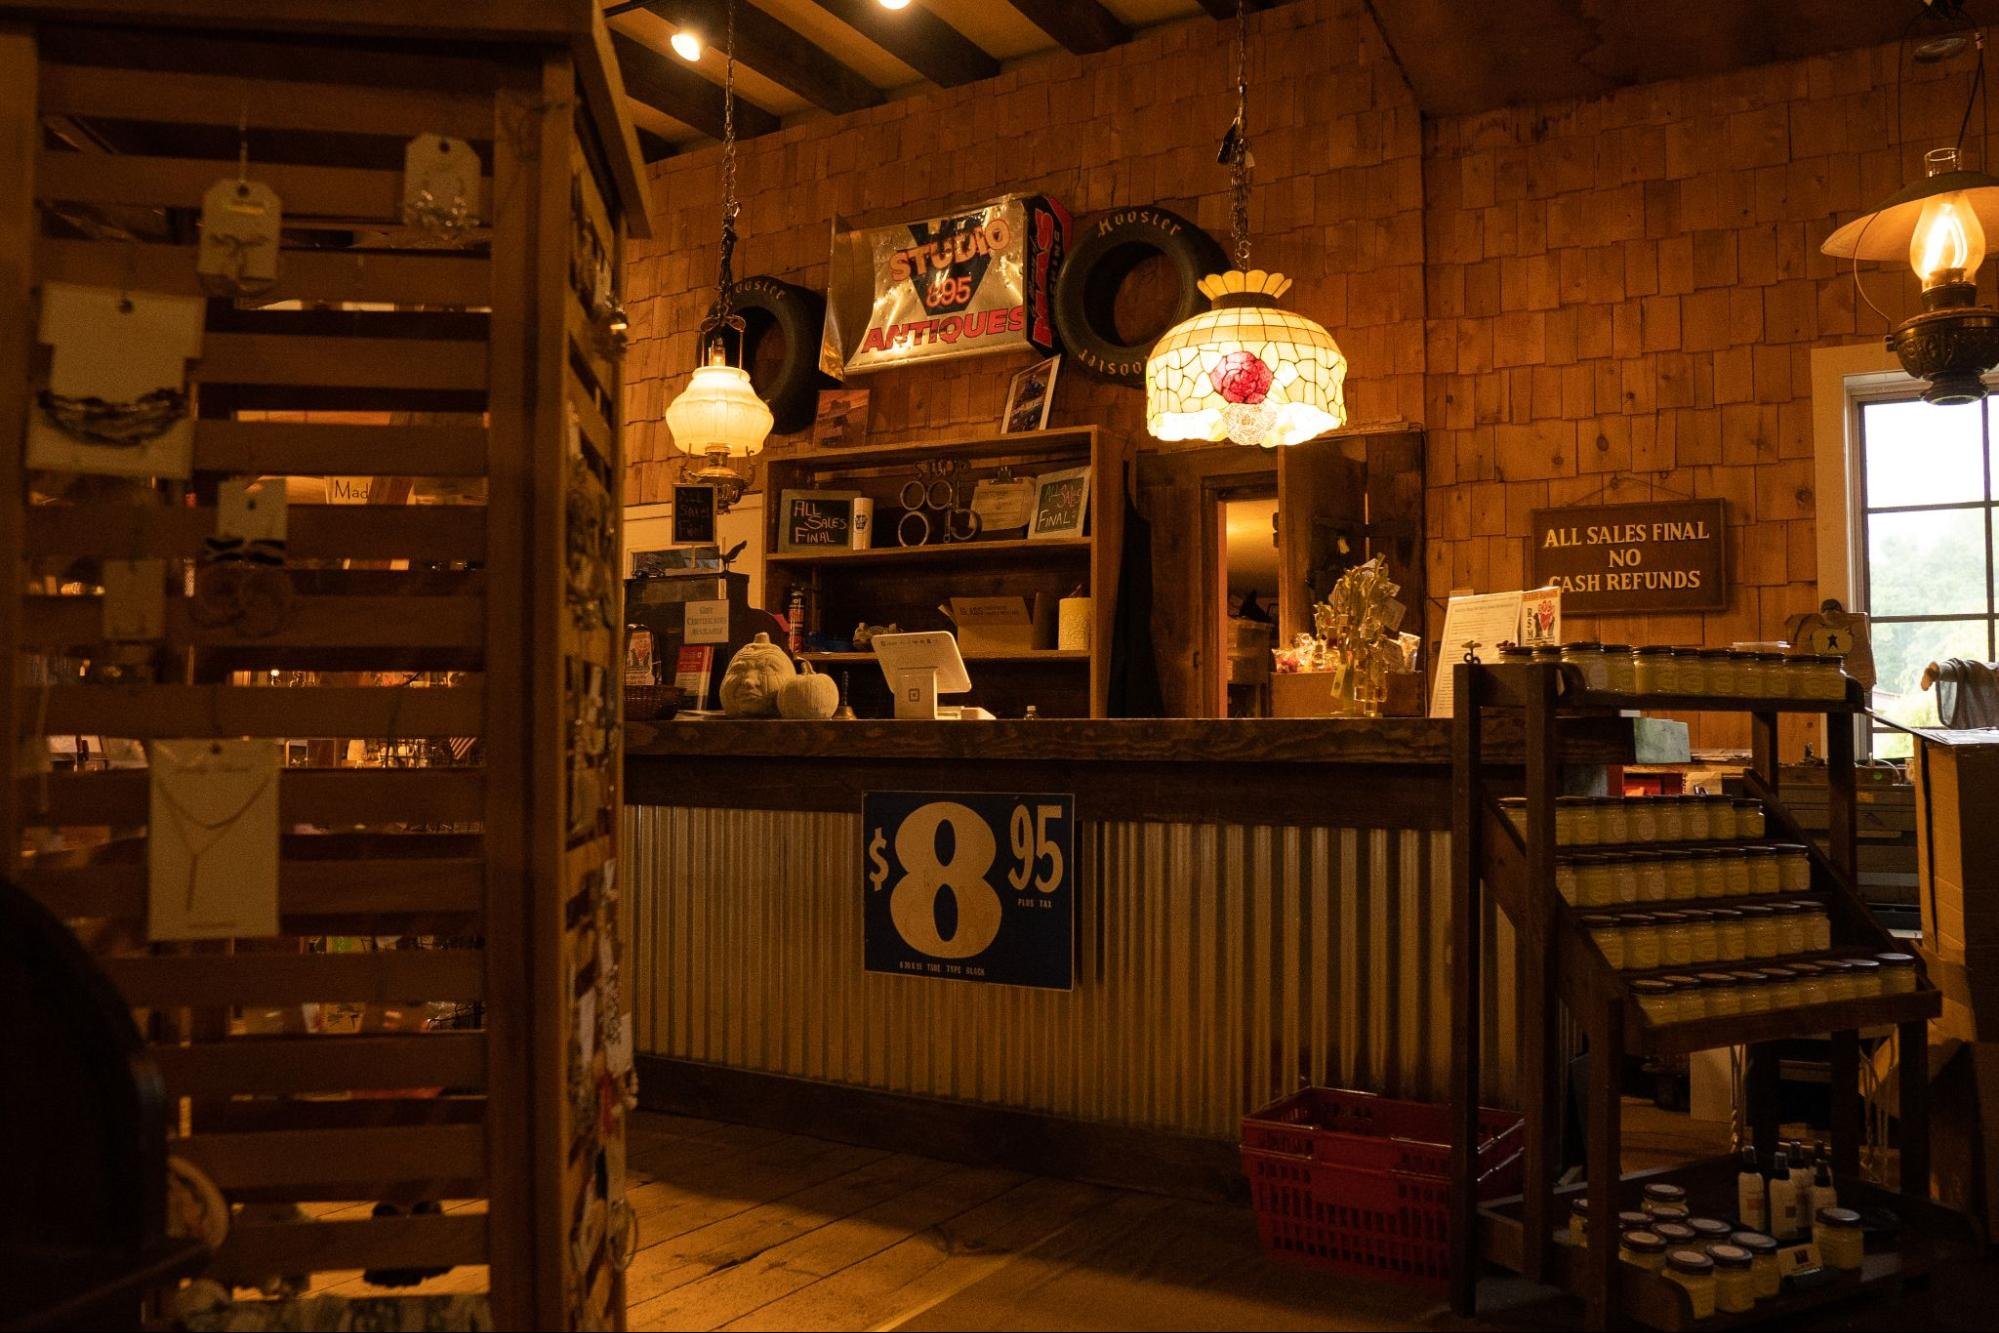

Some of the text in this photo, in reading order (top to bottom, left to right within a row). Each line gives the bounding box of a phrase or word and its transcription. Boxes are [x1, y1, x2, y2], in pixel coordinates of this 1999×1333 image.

[889, 218, 1011, 282] STUDIO
[861, 304, 1025, 353] ANTIQUES
[793, 500, 823, 518] ALL
[1037, 509, 1070, 531] FINAL
[804, 517, 848, 530] SALES
[1544, 521, 1710, 548] ALL SALES FINAL
[794, 527, 837, 544] FINAL
[1608, 548, 1642, 568] NO
[1549, 570, 1701, 593] CASH REFUNDS
[1007, 803, 1064, 894] 95
